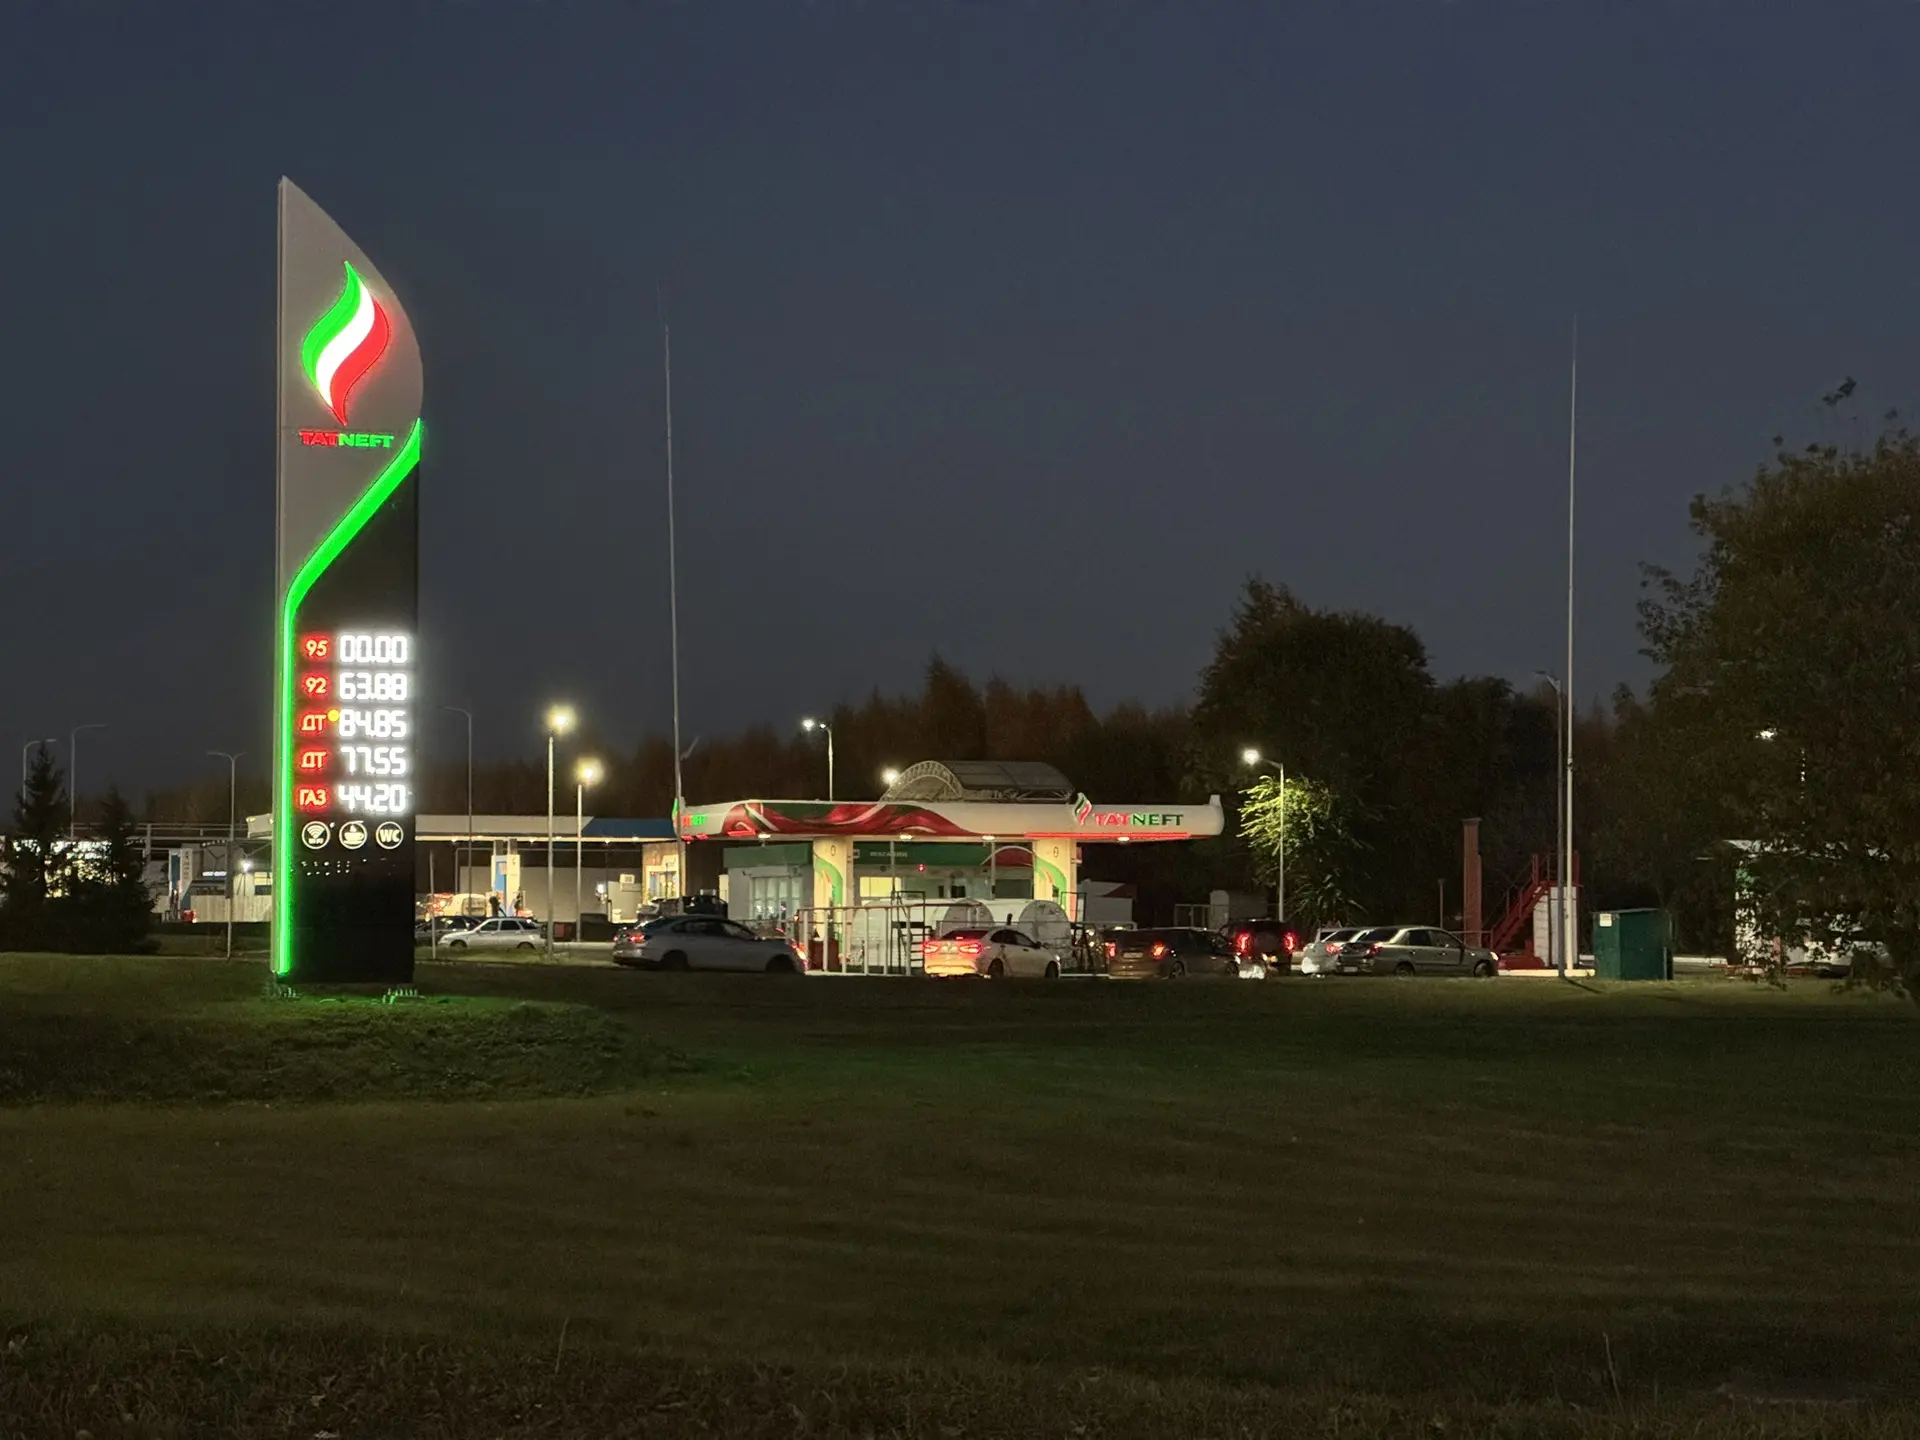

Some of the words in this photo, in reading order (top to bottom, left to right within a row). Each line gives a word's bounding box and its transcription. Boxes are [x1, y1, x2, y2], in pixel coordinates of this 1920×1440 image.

[299, 431, 394, 448] TATNEFT
[306, 639, 328, 657] 95
[339, 635, 407, 663] 00.00
[305, 677, 327, 694] 92
[339, 672, 407, 700] 63.88
[301, 714, 327, 731] ДТ
[339, 709, 407, 738] 84.85
[301, 751, 327, 768] ДТ
[340, 746, 407, 775] 77.55
[299, 788, 327, 806] ГАЗ
[338, 784, 406, 812] 44.20
[1094, 812, 1184, 827] TATNEFT
[379, 829, 401, 843] WC
